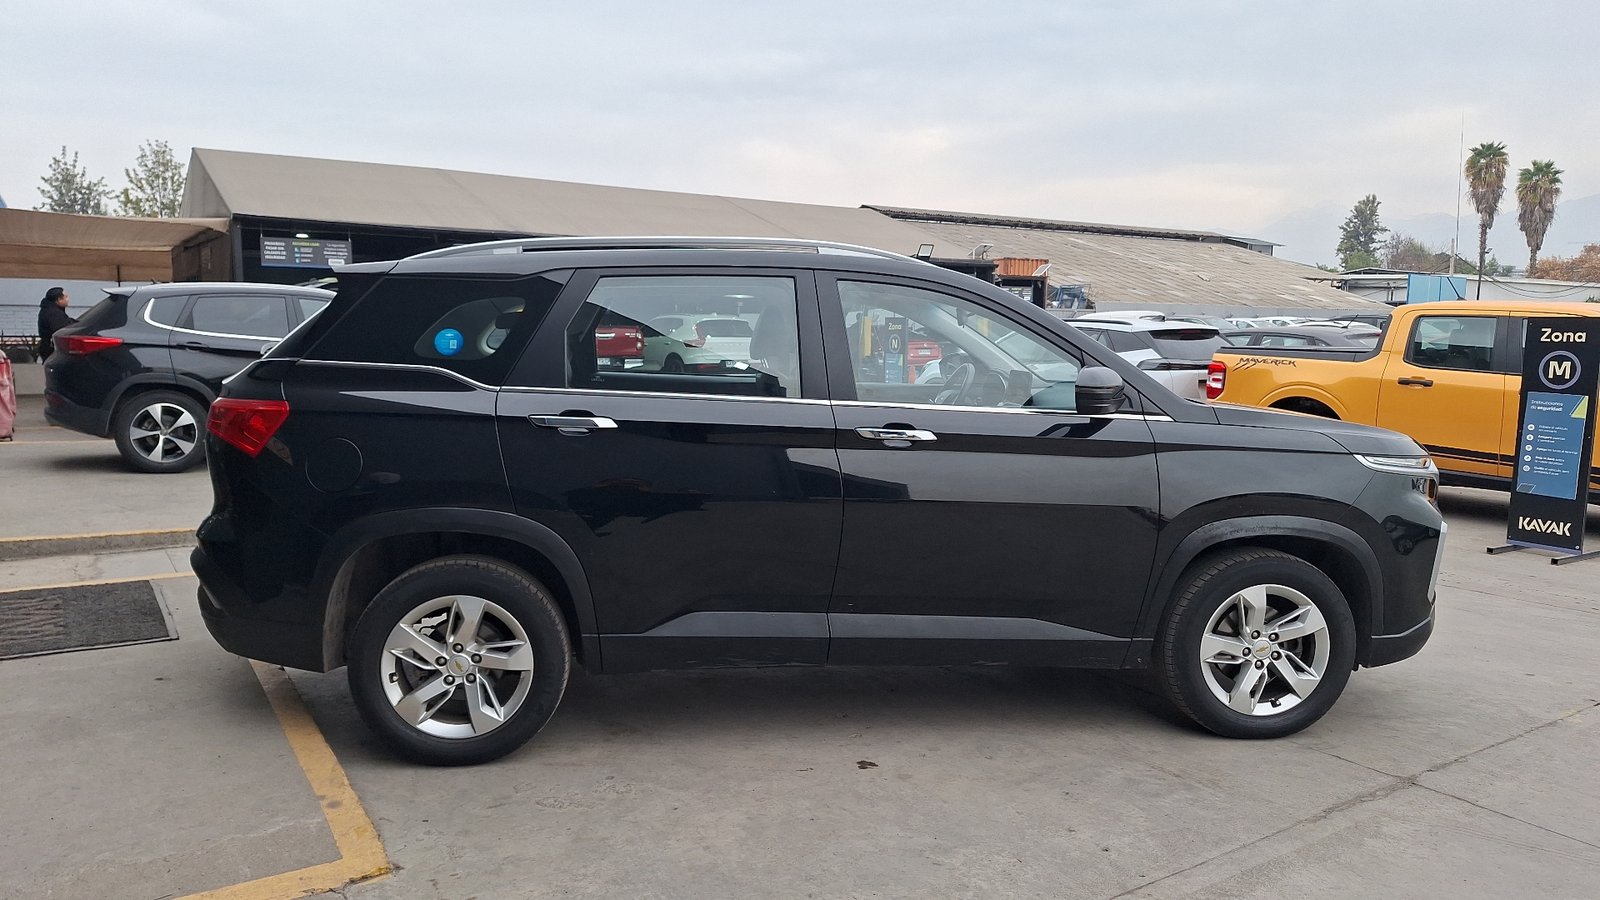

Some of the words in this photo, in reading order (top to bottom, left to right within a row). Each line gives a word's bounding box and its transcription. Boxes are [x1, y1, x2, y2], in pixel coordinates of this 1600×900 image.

[888, 322, 902, 330] Zona
[1540, 327, 1587, 343] Zona
[892, 339, 898, 349] N
[1236, 357, 1297, 370] MAVERICK
[1548, 361, 1572, 379] M
[1518, 516, 1572, 537] KAVAK
